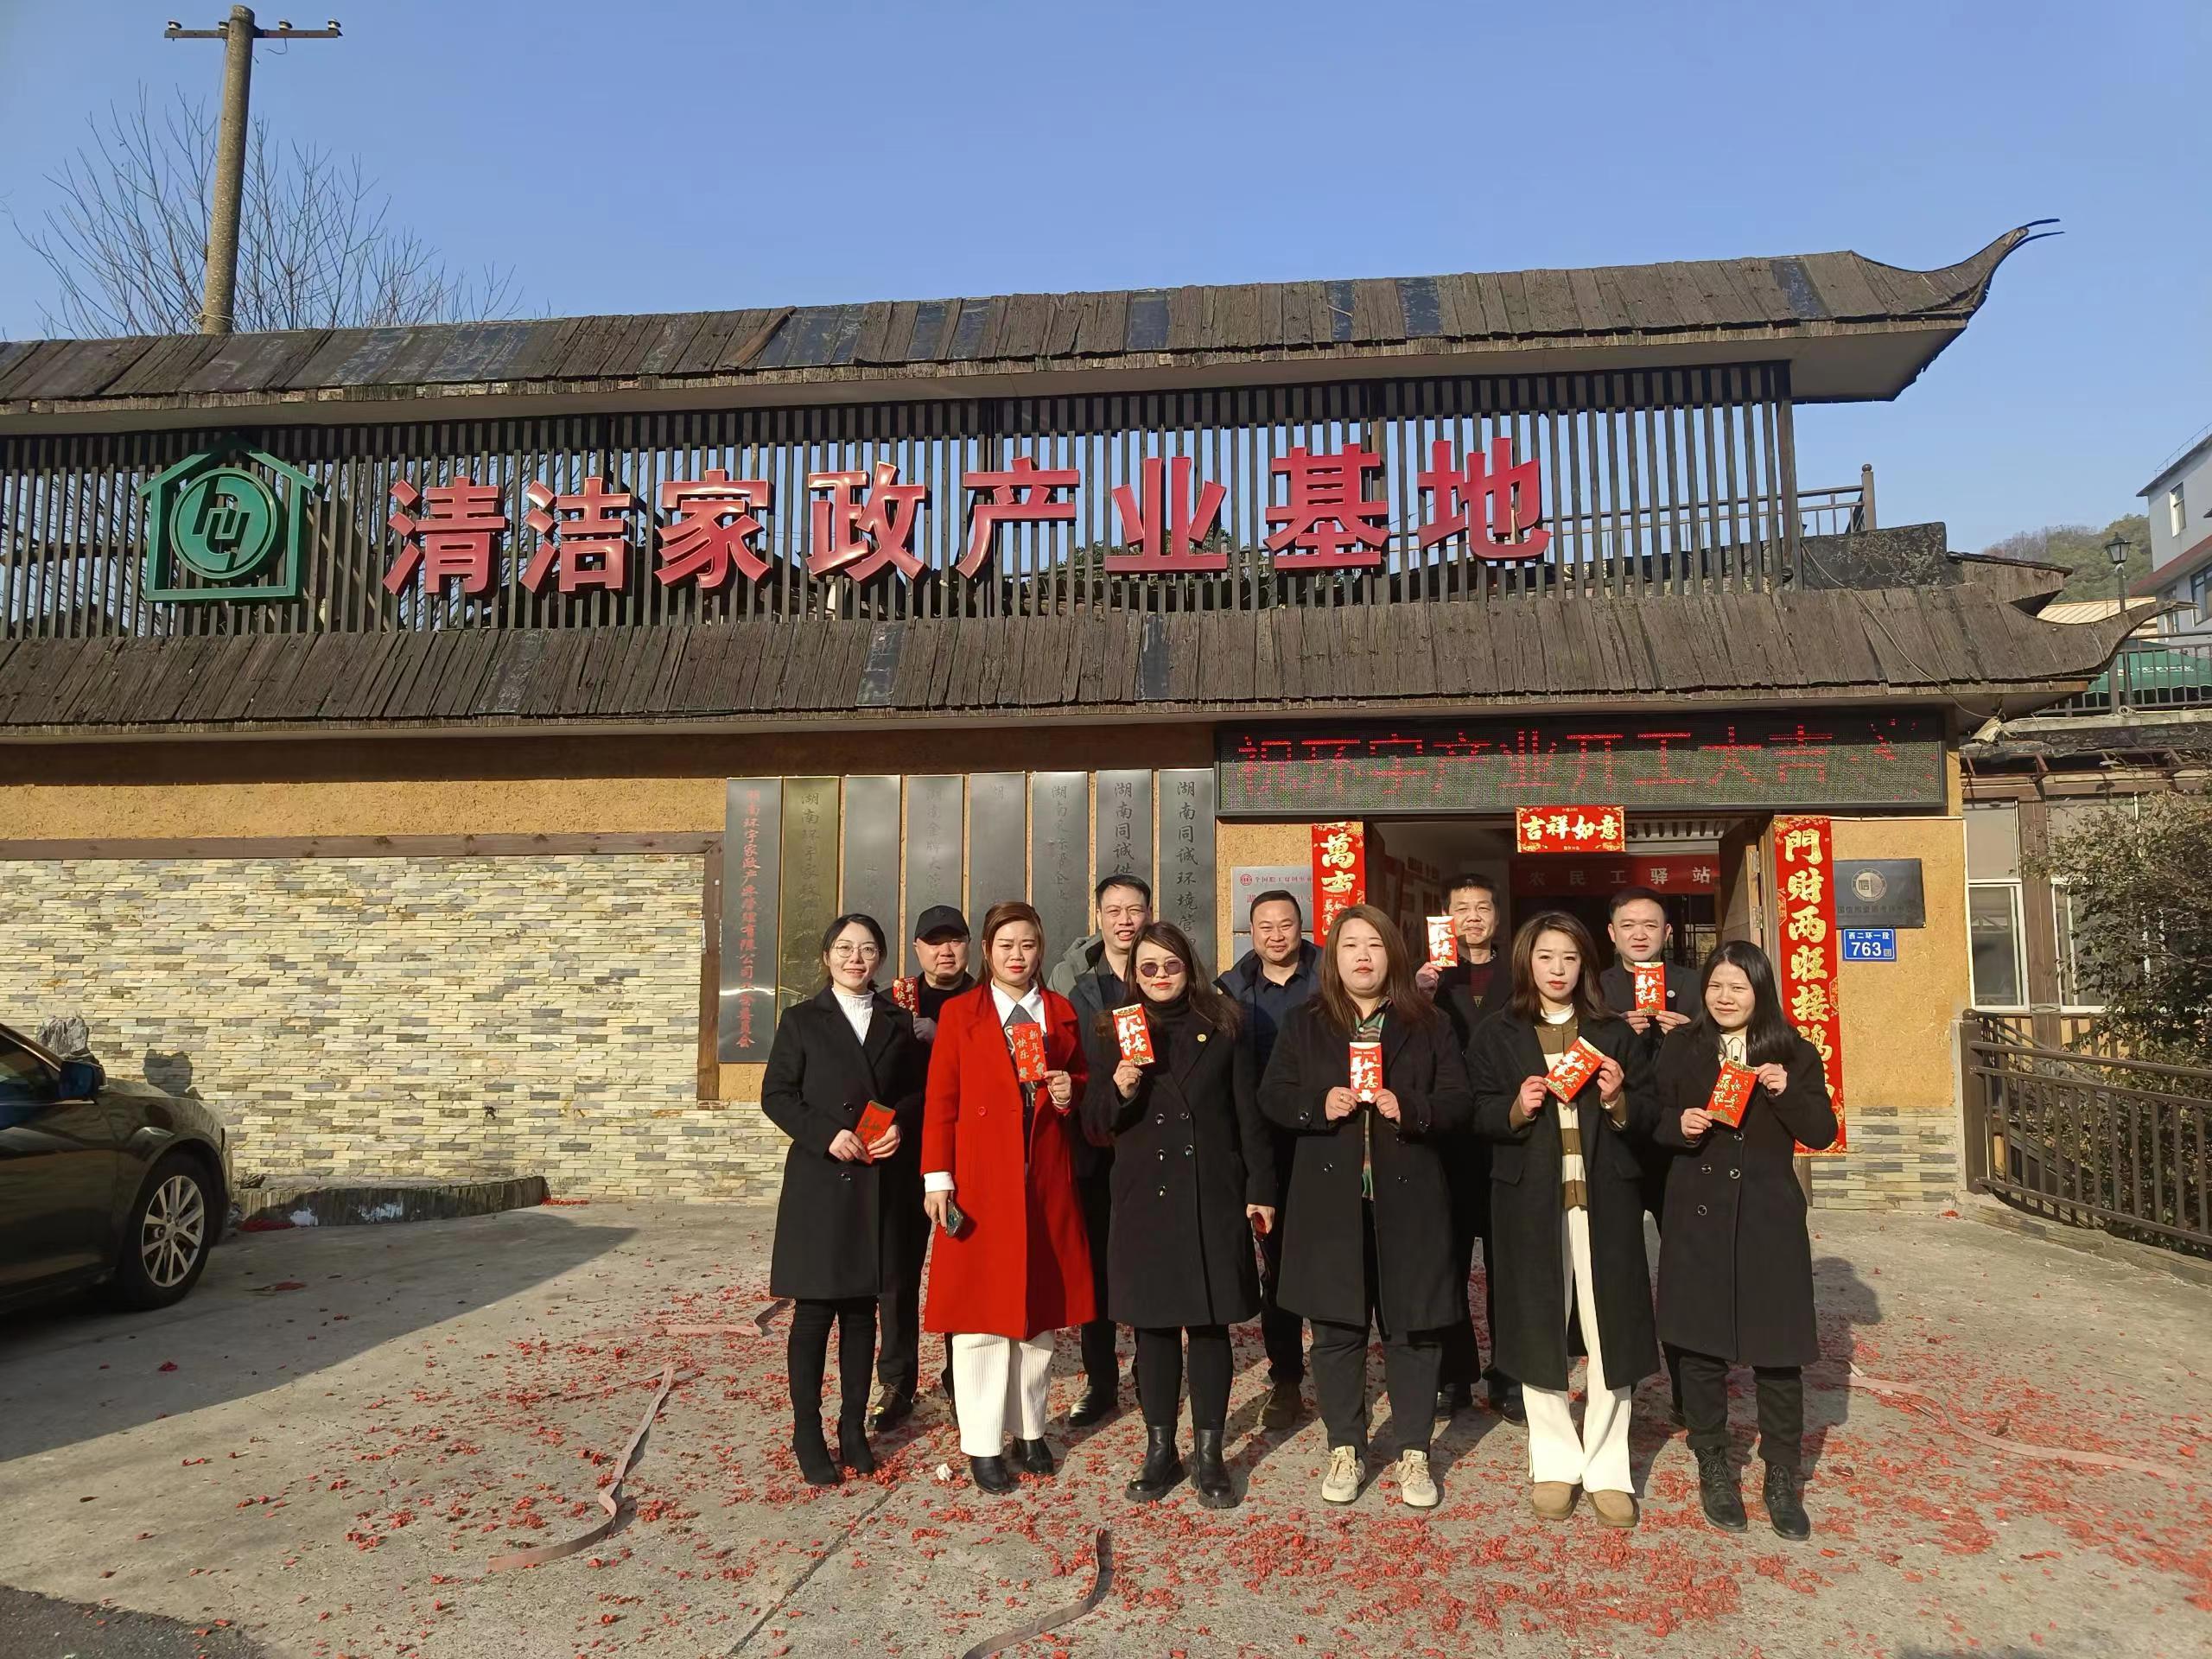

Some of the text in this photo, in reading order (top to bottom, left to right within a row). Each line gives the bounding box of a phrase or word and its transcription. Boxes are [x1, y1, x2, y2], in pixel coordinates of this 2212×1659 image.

[382, 437, 1551, 597] 清洁家政产业基地
[1522, 815, 1620, 840] 吉祥如意
[1529, 866, 1711, 886] 农民工驿站
[1848, 931, 1890, 940] 西二环一段
[1851, 942, 1882, 957] 763
